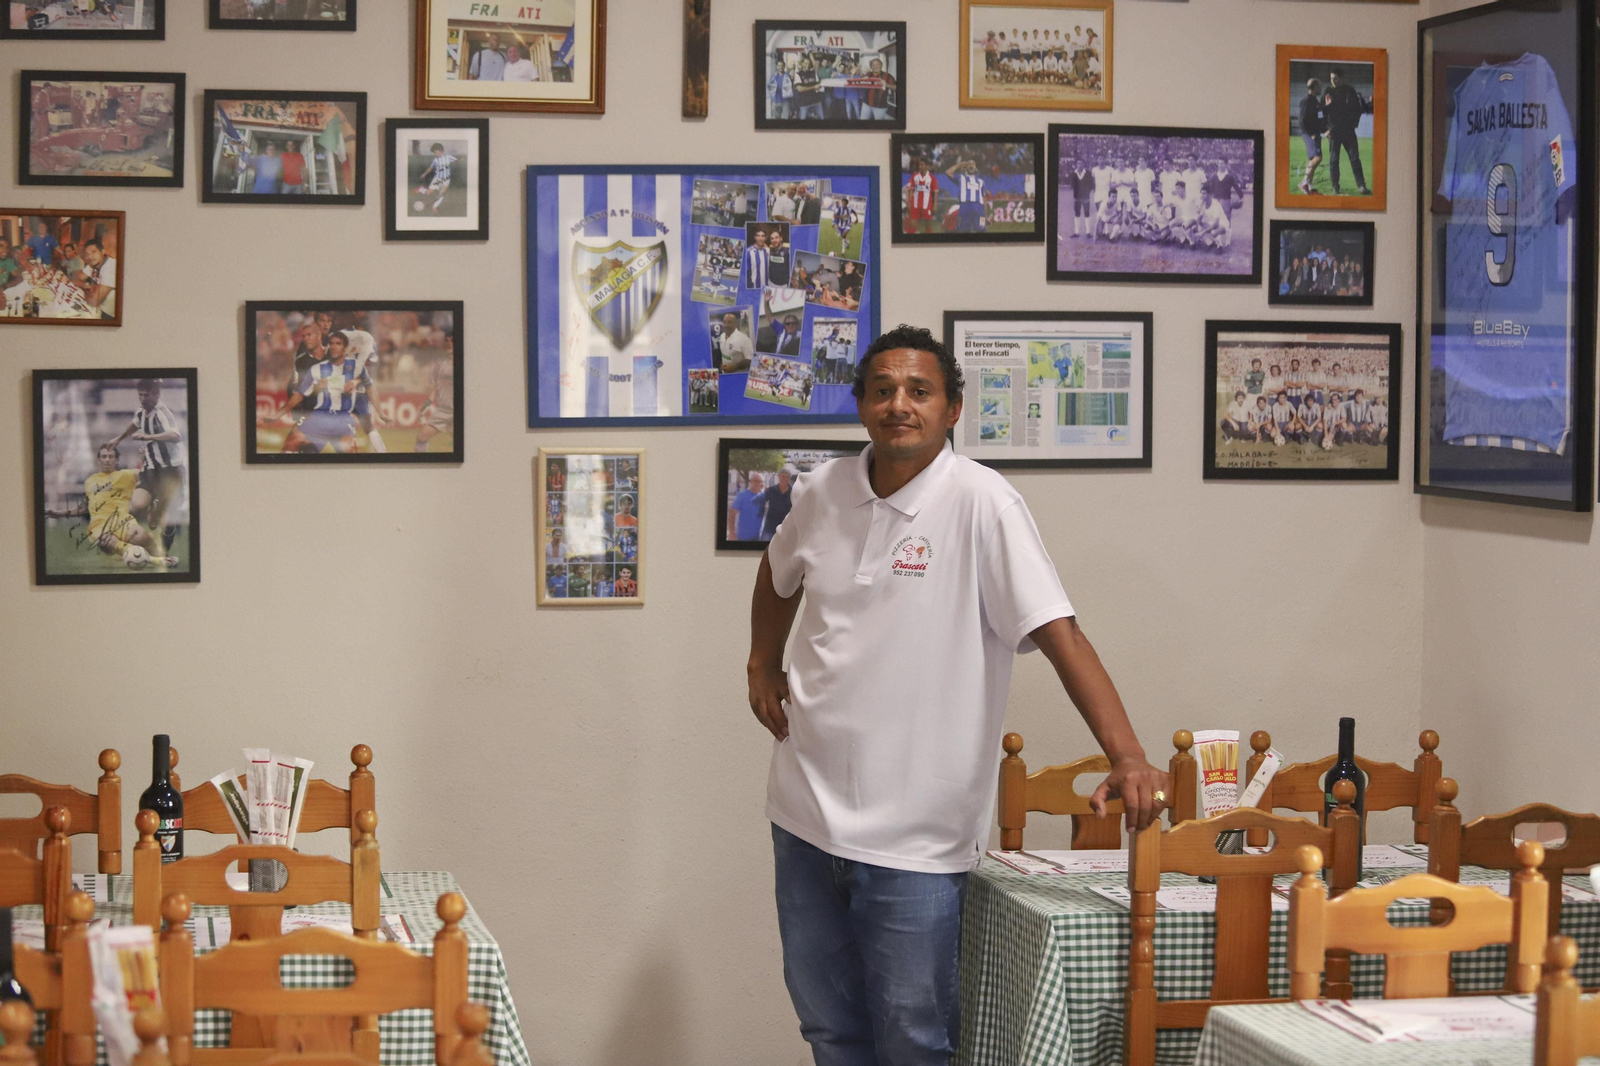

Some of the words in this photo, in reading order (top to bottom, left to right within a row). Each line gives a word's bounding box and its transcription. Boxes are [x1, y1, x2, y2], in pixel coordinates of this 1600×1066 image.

[1466, 105, 1496, 136] SALVA
[1498, 102, 1548, 130] BALLESTA
[1485, 163, 1517, 287] 9
[1473, 319, 1531, 340] BlueBay
[974, 349, 982, 357] el
[982, 349, 1010, 357] Frascati
[994, 341, 1021, 351] tiempo,
[891, 559, 929, 571] Frascati
